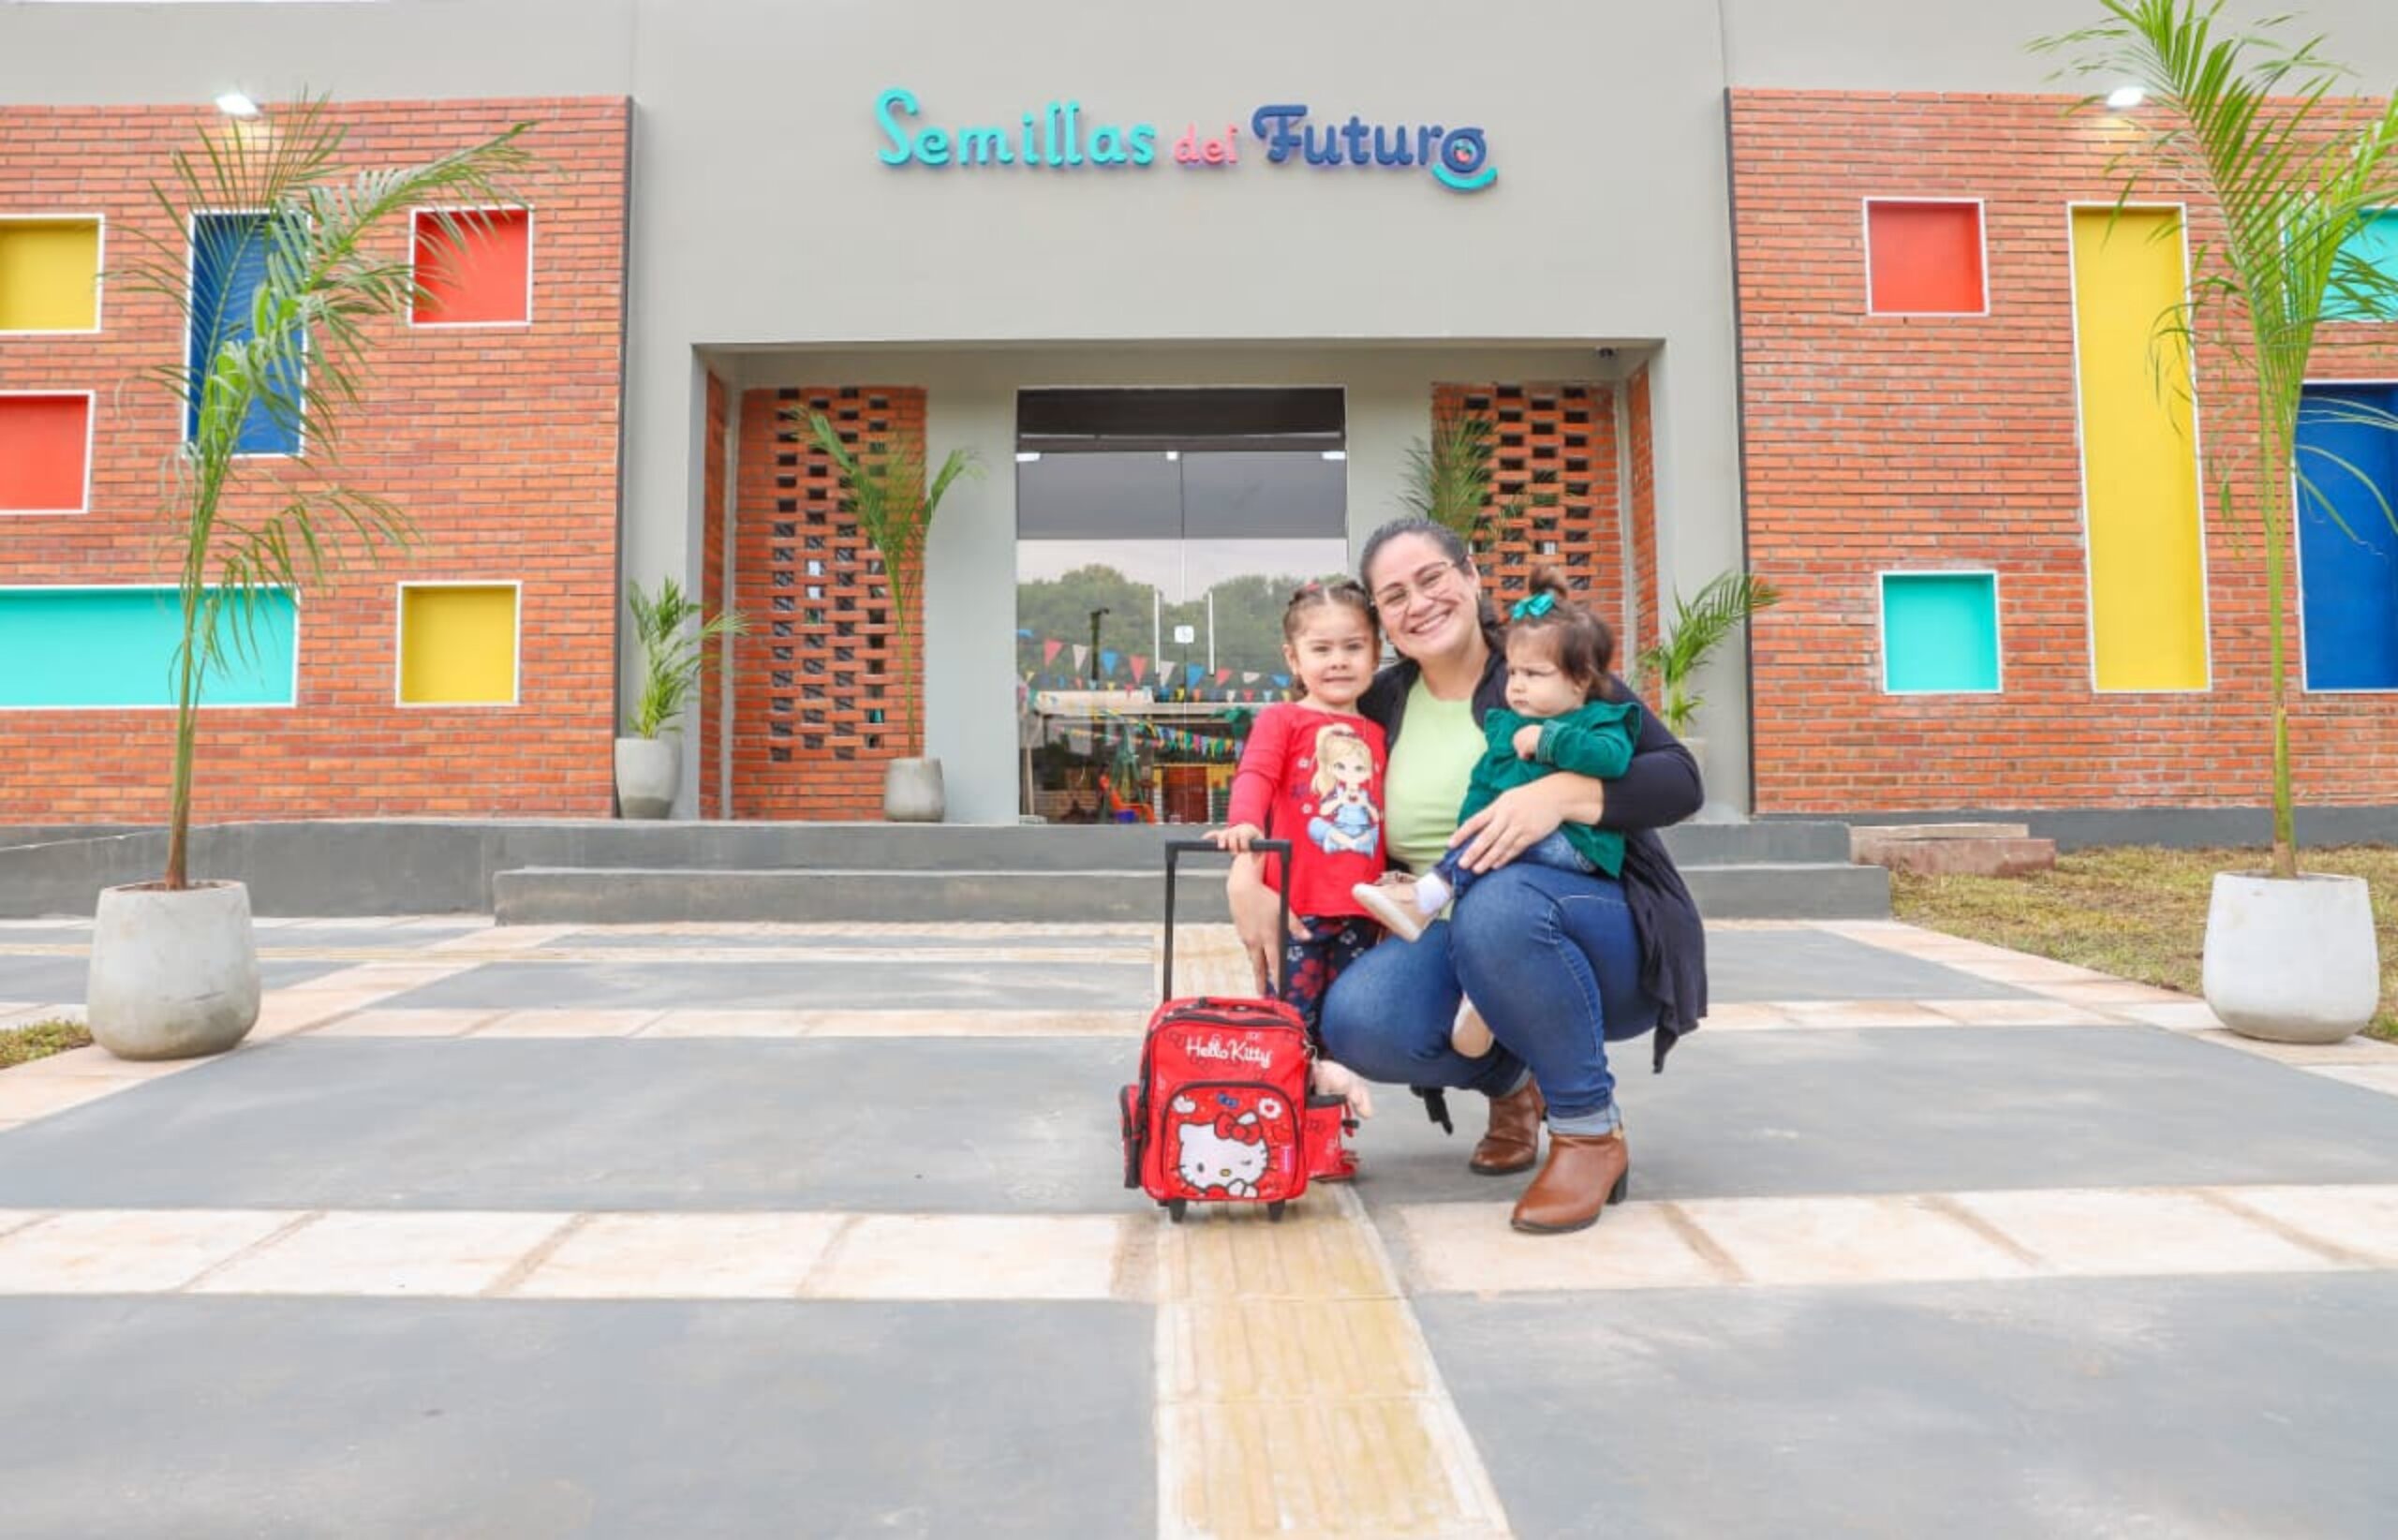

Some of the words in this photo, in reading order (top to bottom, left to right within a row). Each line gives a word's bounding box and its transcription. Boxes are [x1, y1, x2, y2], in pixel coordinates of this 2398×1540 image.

[874, 88, 1156, 167] Semillas
[1173, 122, 1238, 165] del
[1251, 104, 1488, 175] Futuro
[1186, 1036, 1229, 1059] Hello
[1227, 1038, 1272, 1069] Kitty
